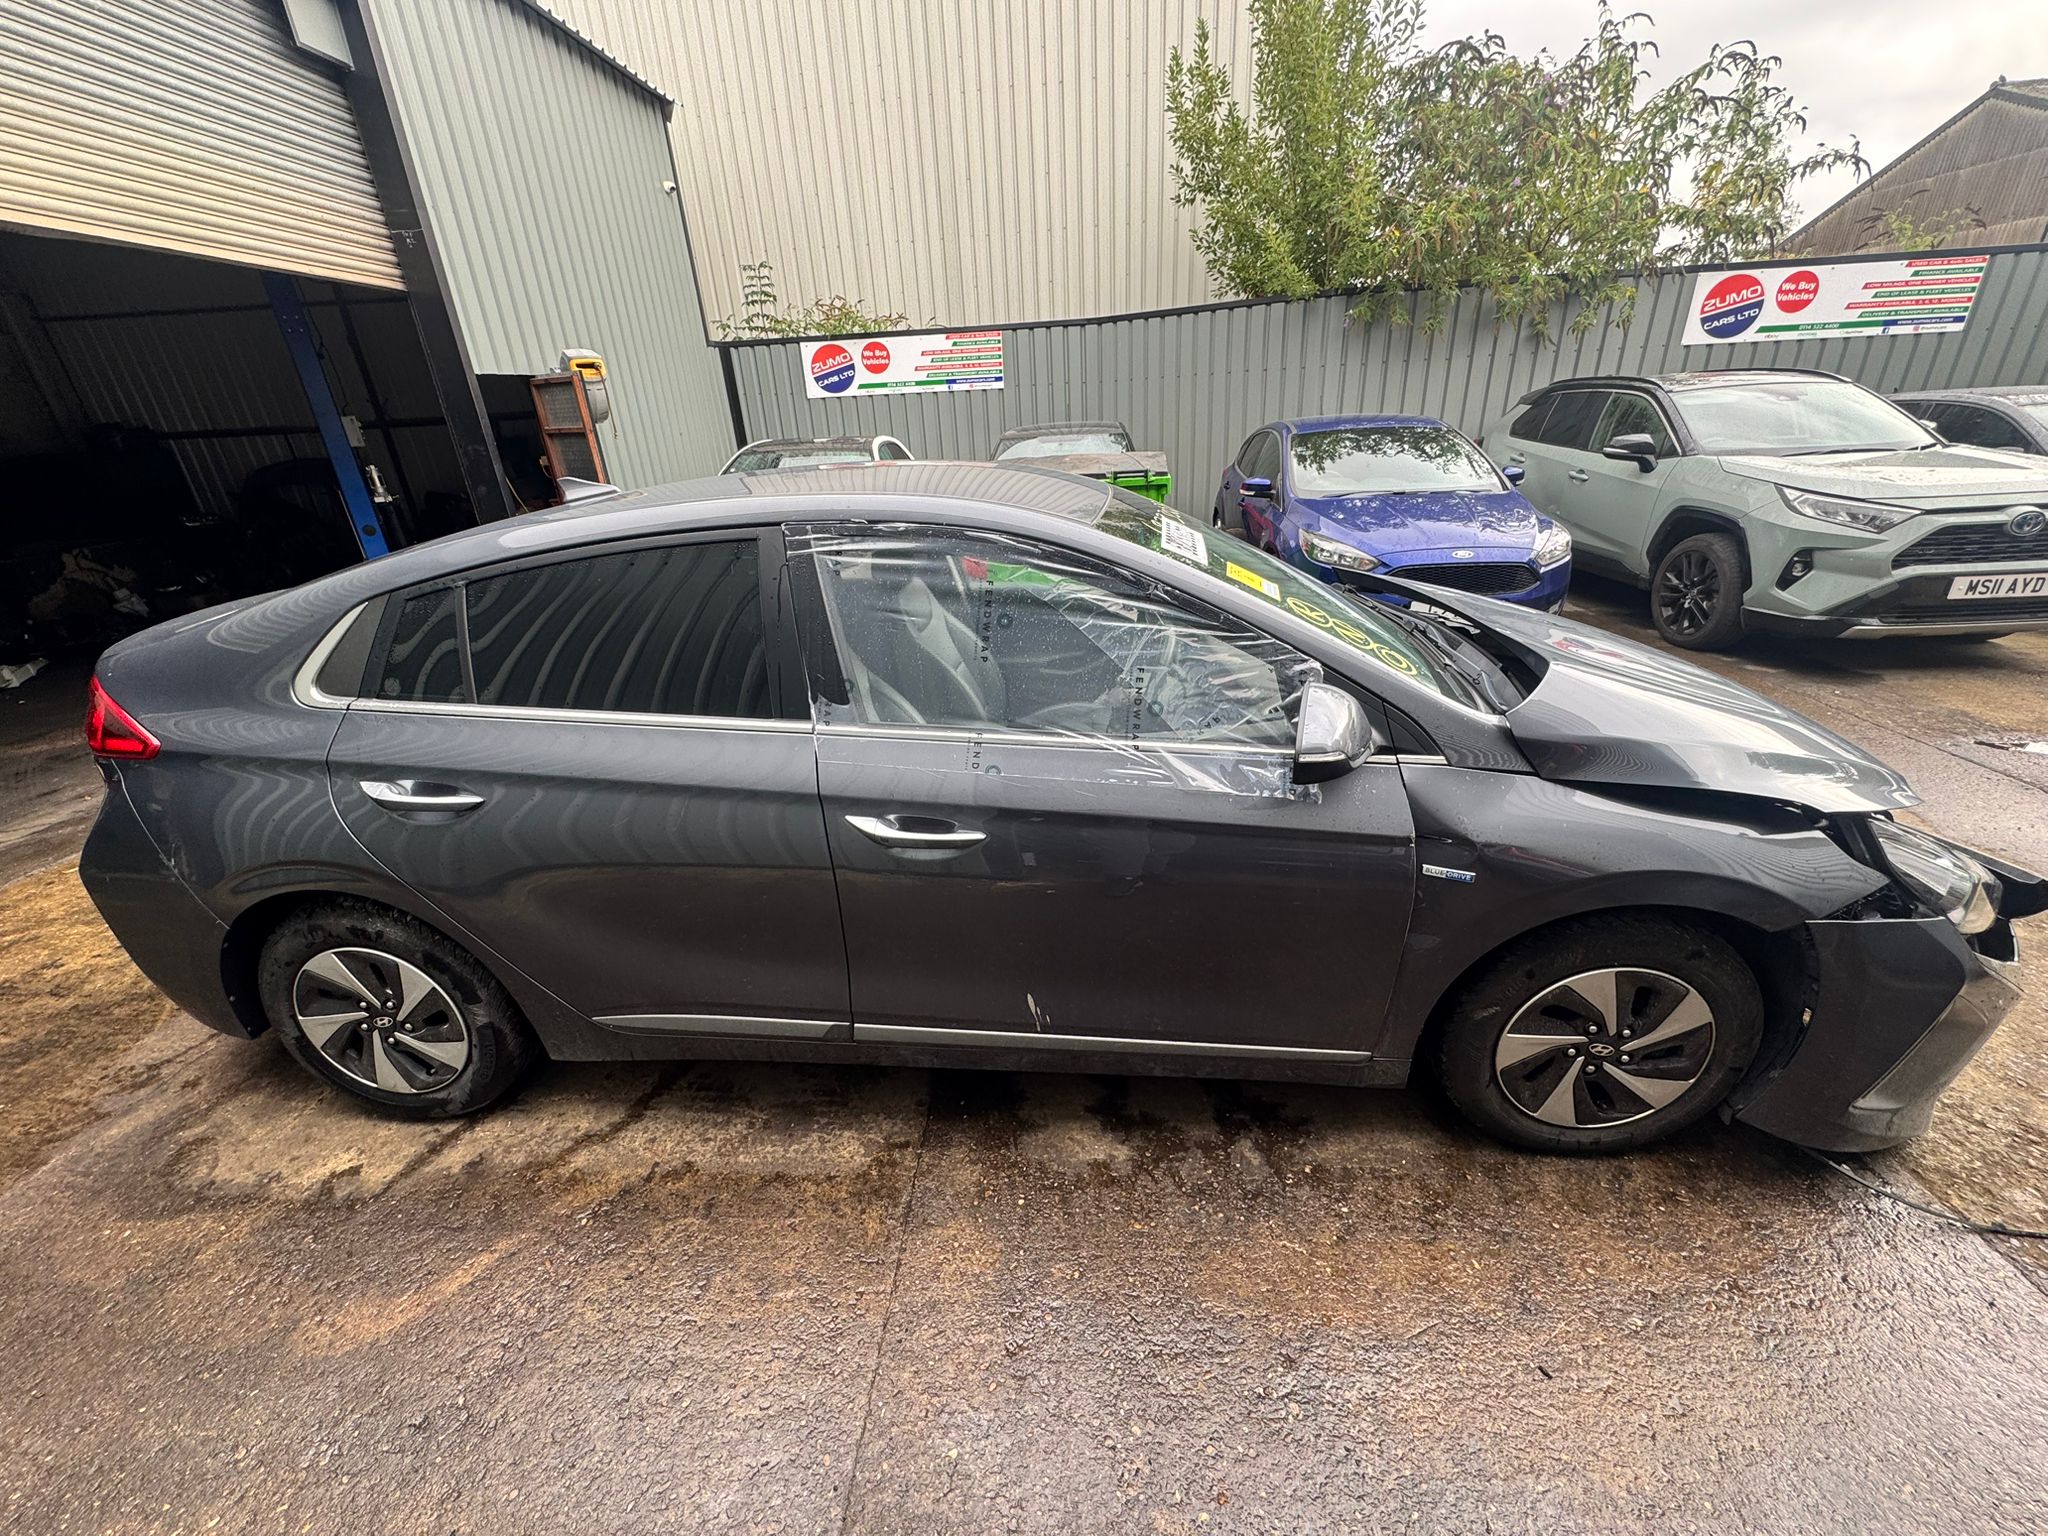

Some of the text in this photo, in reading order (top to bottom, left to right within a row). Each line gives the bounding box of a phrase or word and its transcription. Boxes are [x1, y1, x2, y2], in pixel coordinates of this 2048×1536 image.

[1782, 281, 1816, 291] We Buy
[1703, 285, 1761, 312] ZUMO
[1777, 292, 1814, 302] Vehicles
[1703, 308, 1760, 330] CARS LTD
[1896, 308, 1932, 316] TRANSPORT
[812, 352, 851, 373] ZUMO
[874, 349, 888, 357] Buy
[818, 369, 854, 387] CARS LTD
[1964, 576, 2046, 596] MS11 AYD
[980, 580, 994, 663] FENDWRAP
[1132, 667, 1145, 751] FENDWRAP
